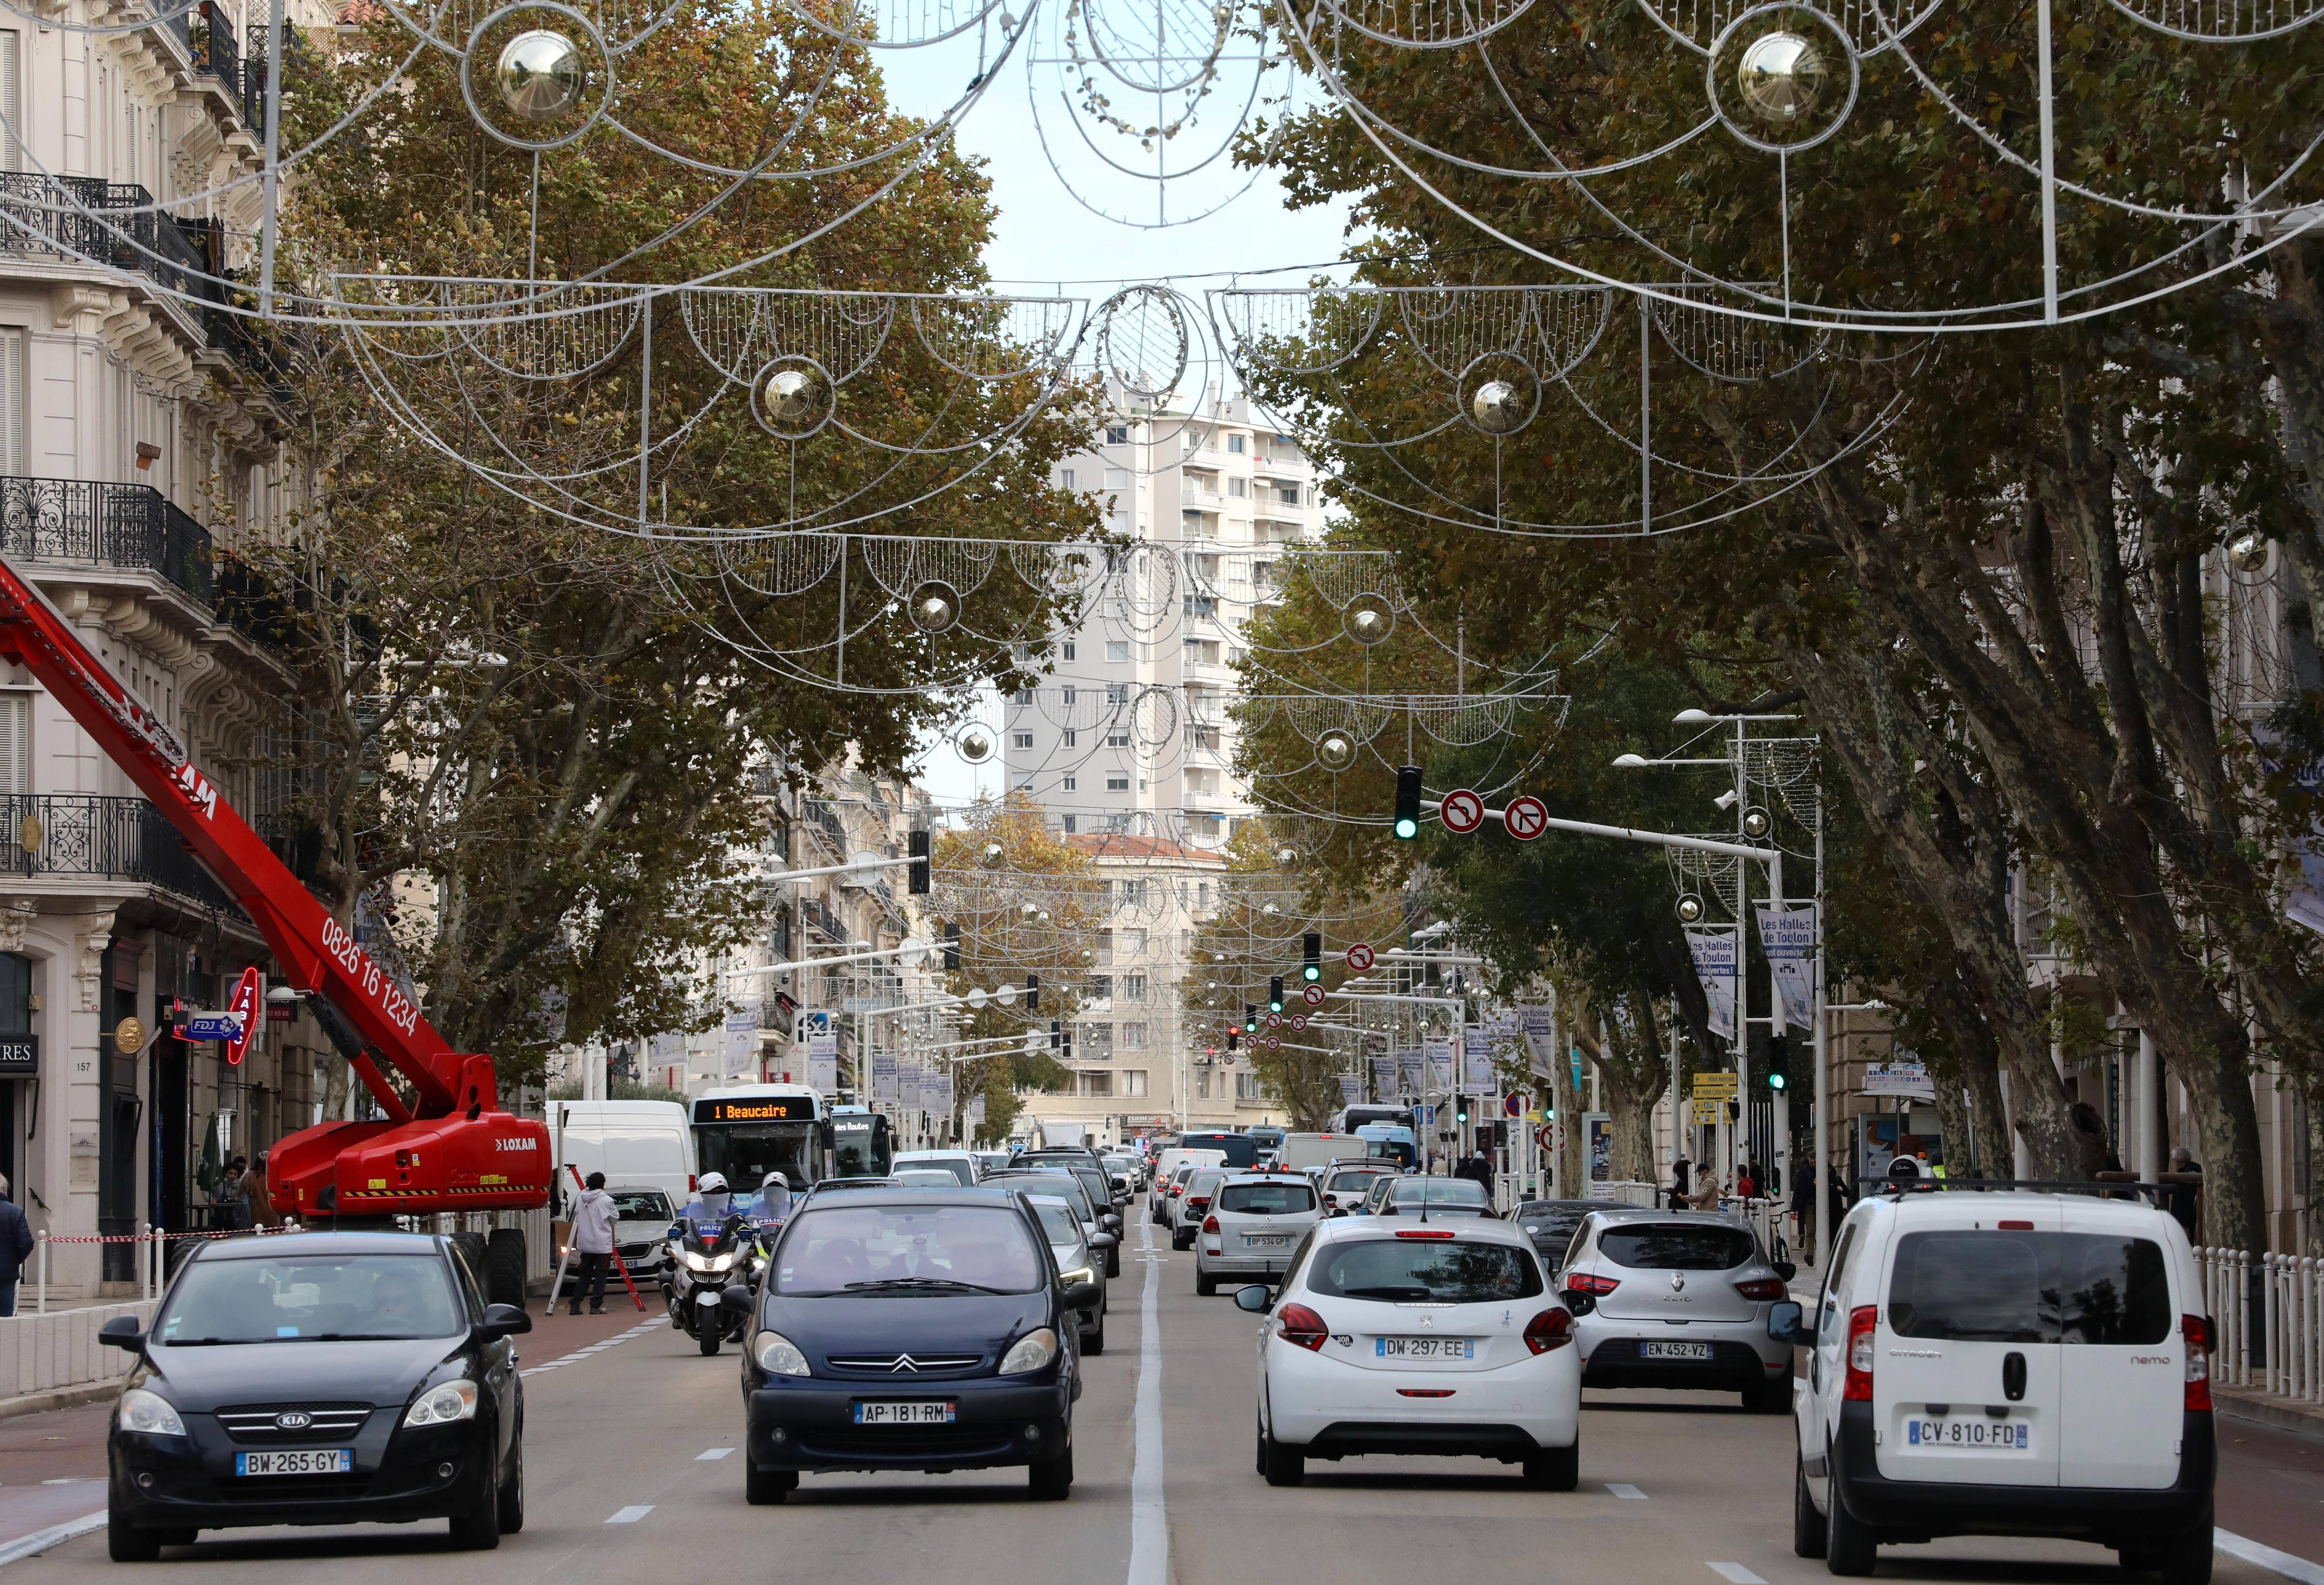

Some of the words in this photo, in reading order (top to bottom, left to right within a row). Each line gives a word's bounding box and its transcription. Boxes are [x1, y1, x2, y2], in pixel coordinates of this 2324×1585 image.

[1761, 919, 1776, 930] Les
[1779, 919, 1810, 930] Halles
[1764, 932, 1774, 943] de
[1776, 932, 1809, 943] Toulon
[1706, 941, 1732, 951] Halles
[1702, 952, 1731, 962] Toulon
[1777, 948, 1805, 957] ouverte
[322, 917, 360, 974] 0826
[362, 961, 381, 996] 16
[382, 983, 417, 1037] 1234
[194, 1021, 216, 1030] FDJ
[0, 1045, 30, 1060] RES
[77, 1063, 90, 1071] 157
[715, 1106, 720, 1118] 1
[727, 1104, 786, 1118] Beaucaire
[503, 1138, 536, 1150] LOXAM
[1387, 1340, 1463, 1355] DW-297-EE
[1649, 1343, 1705, 1356] EN-452-VZ
[865, 1406, 944, 1421] AP-181-RM
[282, 1416, 305, 1425] KIA
[1922, 1423, 2014, 1444] CV-810-FD
[249, 1453, 337, 1473] BW-265-GY
